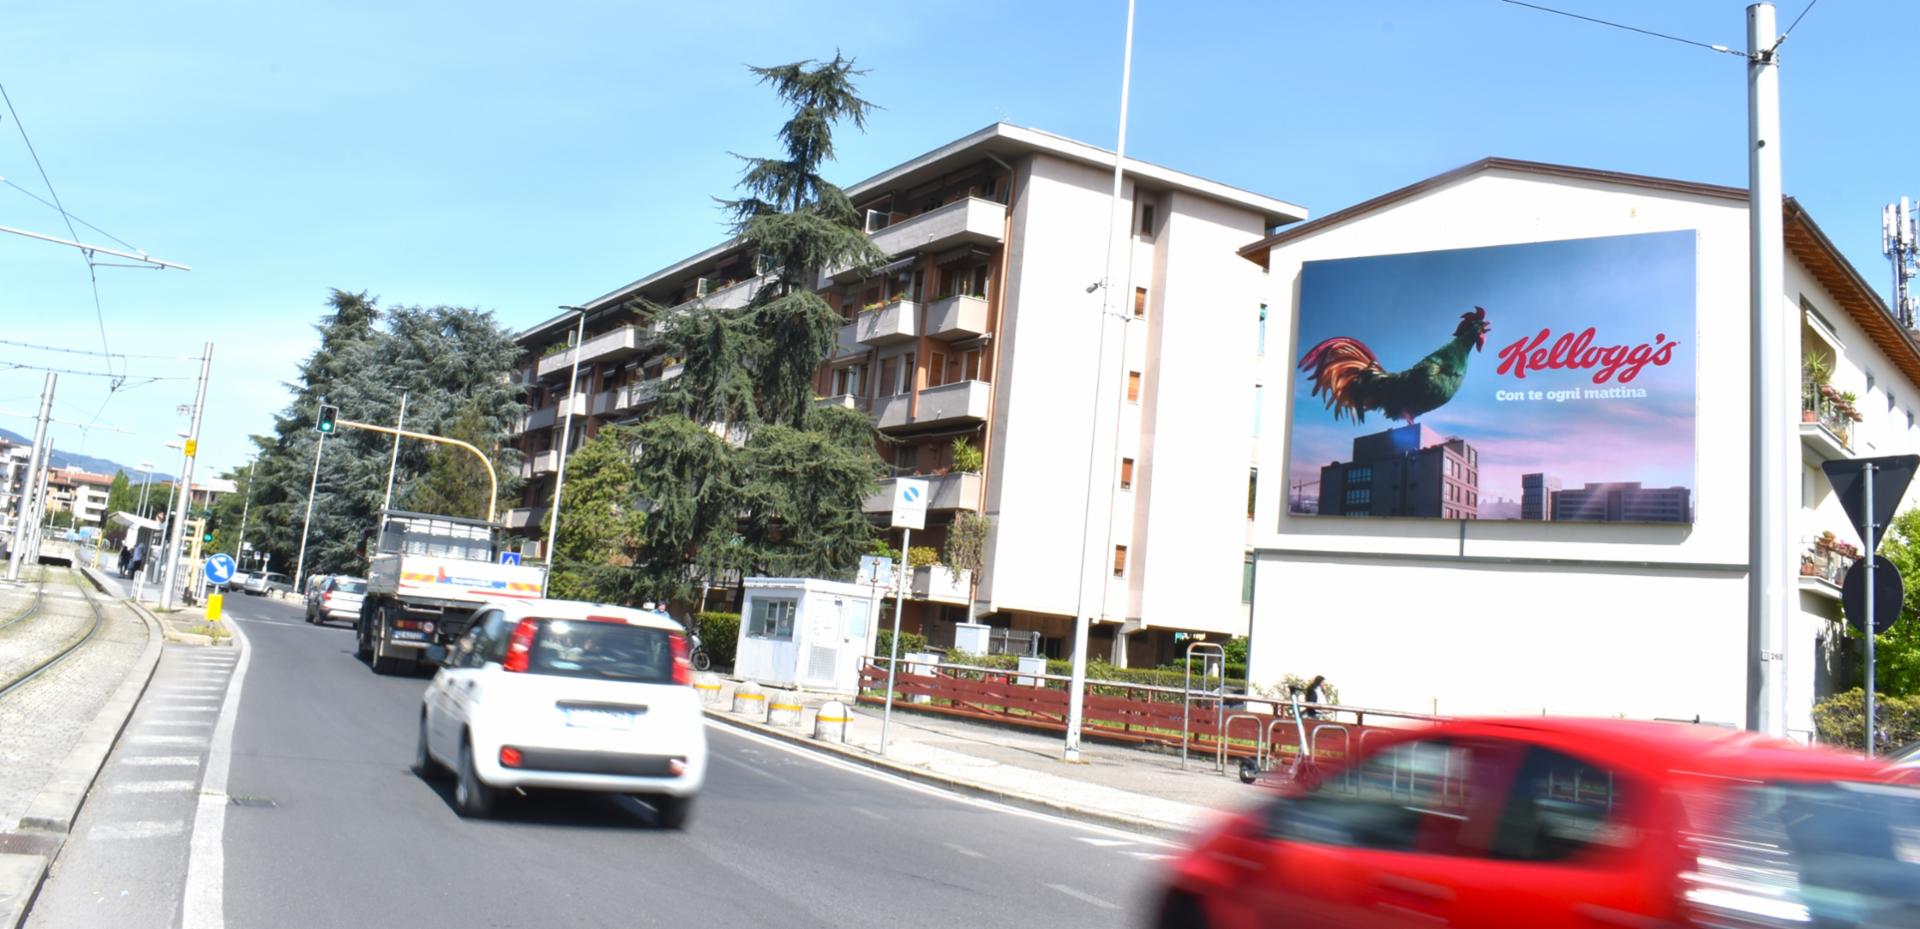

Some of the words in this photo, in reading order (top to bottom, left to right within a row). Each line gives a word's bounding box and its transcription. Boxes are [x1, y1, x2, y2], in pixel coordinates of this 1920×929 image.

[1496, 327, 1678, 384] Kellogg's
[1496, 390, 1524, 401] Con
[1528, 390, 1543, 401] te
[1546, 388, 1581, 402] ogni
[1584, 386, 1647, 399] mattina
